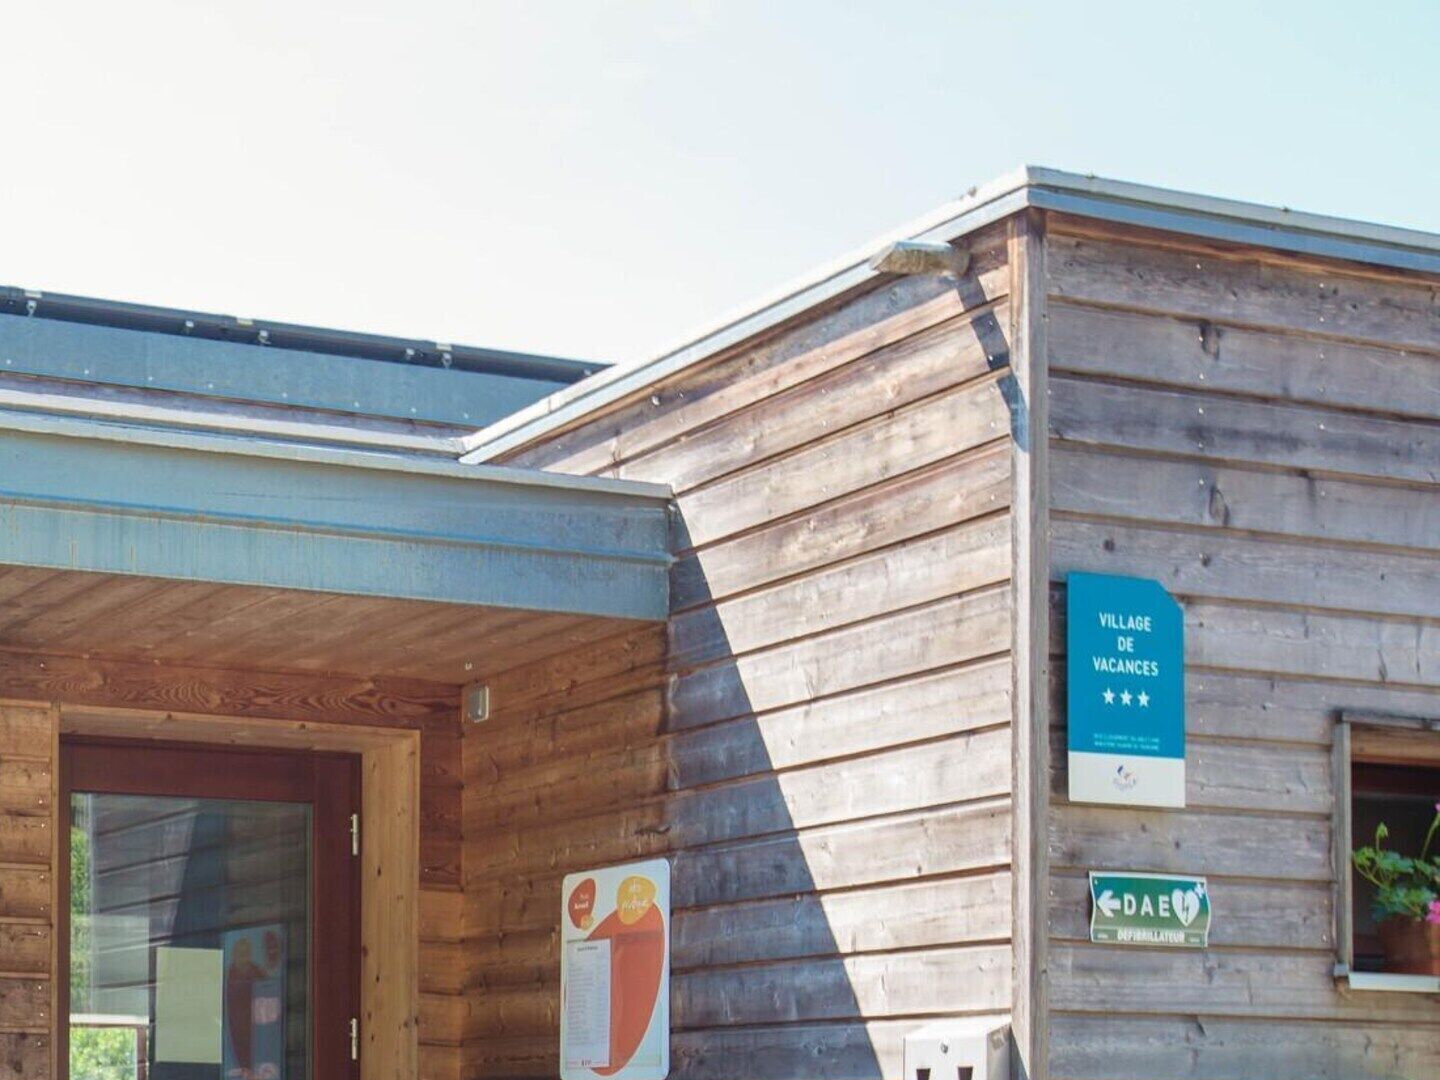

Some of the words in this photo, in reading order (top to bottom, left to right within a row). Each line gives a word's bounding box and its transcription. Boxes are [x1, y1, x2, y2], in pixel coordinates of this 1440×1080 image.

[1099, 612, 1152, 633] VILLAGE
[1117, 636, 1134, 653] DE
[1092, 655, 1159, 677] VACANCES
[1123, 893, 1171, 917] DAE
